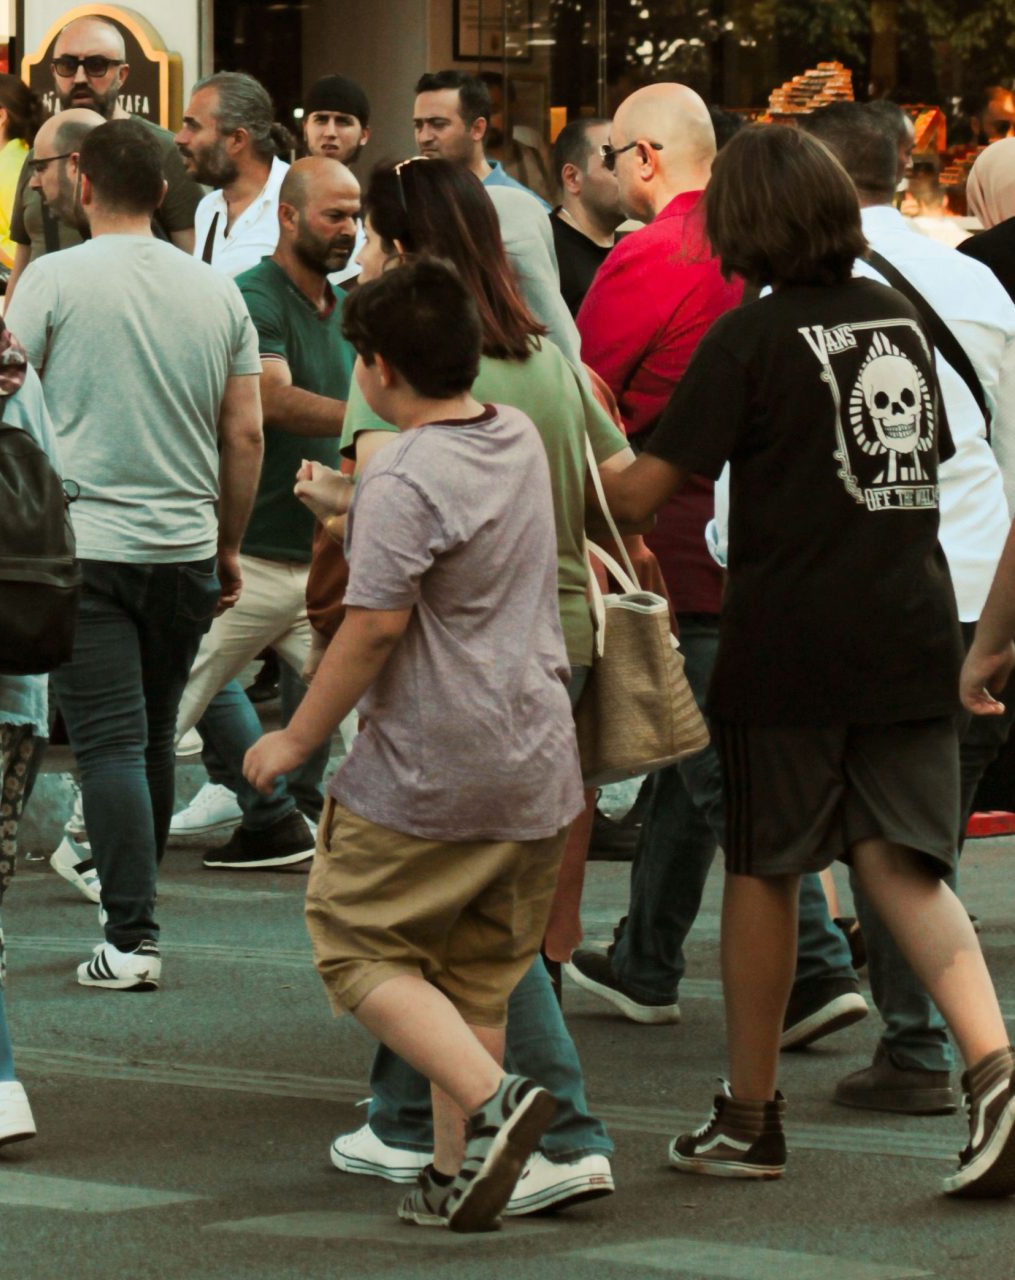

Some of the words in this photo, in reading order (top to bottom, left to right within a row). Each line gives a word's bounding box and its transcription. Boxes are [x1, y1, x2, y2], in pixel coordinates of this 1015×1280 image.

[797, 324, 857, 365] VANS
[864, 488, 891, 511] OFF
[895, 489, 914, 506] THE
